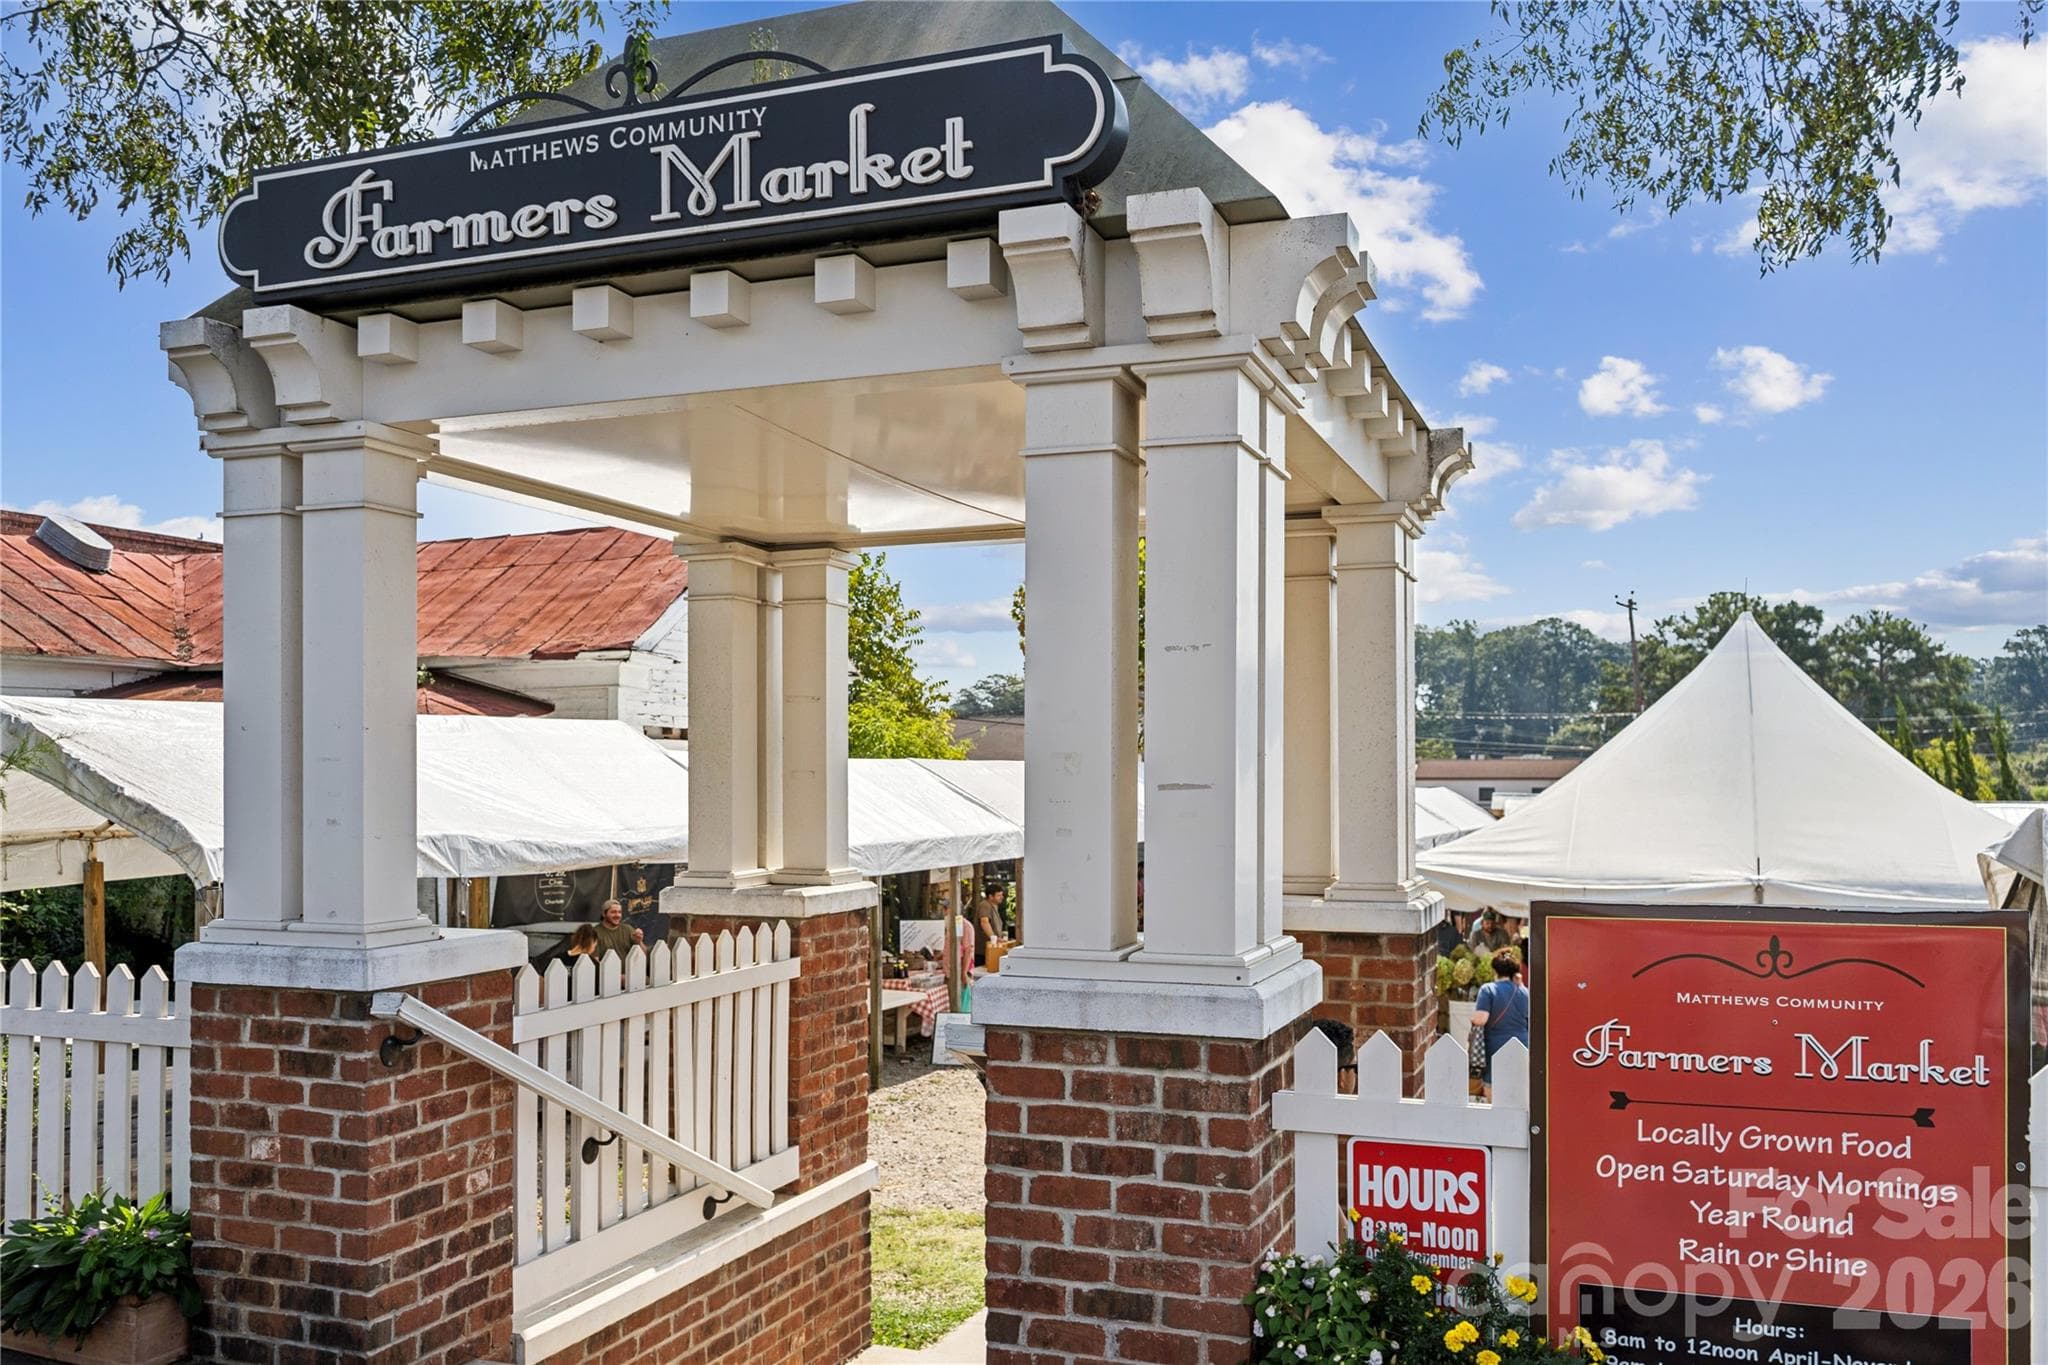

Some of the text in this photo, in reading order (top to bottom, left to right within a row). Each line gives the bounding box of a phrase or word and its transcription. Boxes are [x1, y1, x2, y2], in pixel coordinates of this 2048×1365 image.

[470, 107, 767, 172] MATTHEWS COMMUNITY
[304, 103, 974, 270] Farmers Market
[1676, 992, 1885, 1011] MATTHEWS COMMUNITY
[1572, 1018, 1991, 1087] Farmers Market
[1637, 1118, 1912, 1160] Locally Grown Food
[1358, 1164, 1480, 1215] HOURS
[1596, 1154, 1958, 1208] Open Saturday Mornings
[1690, 1200, 1854, 1236] Year Round
[1678, 1238, 1868, 1277] Rain or Shine
[1605, 1328, 1646, 1349] 8am
[1654, 1336, 1677, 1352] to
[1687, 1338, 1758, 1361] 12noon
[1735, 1317, 1805, 1338] Hours:
